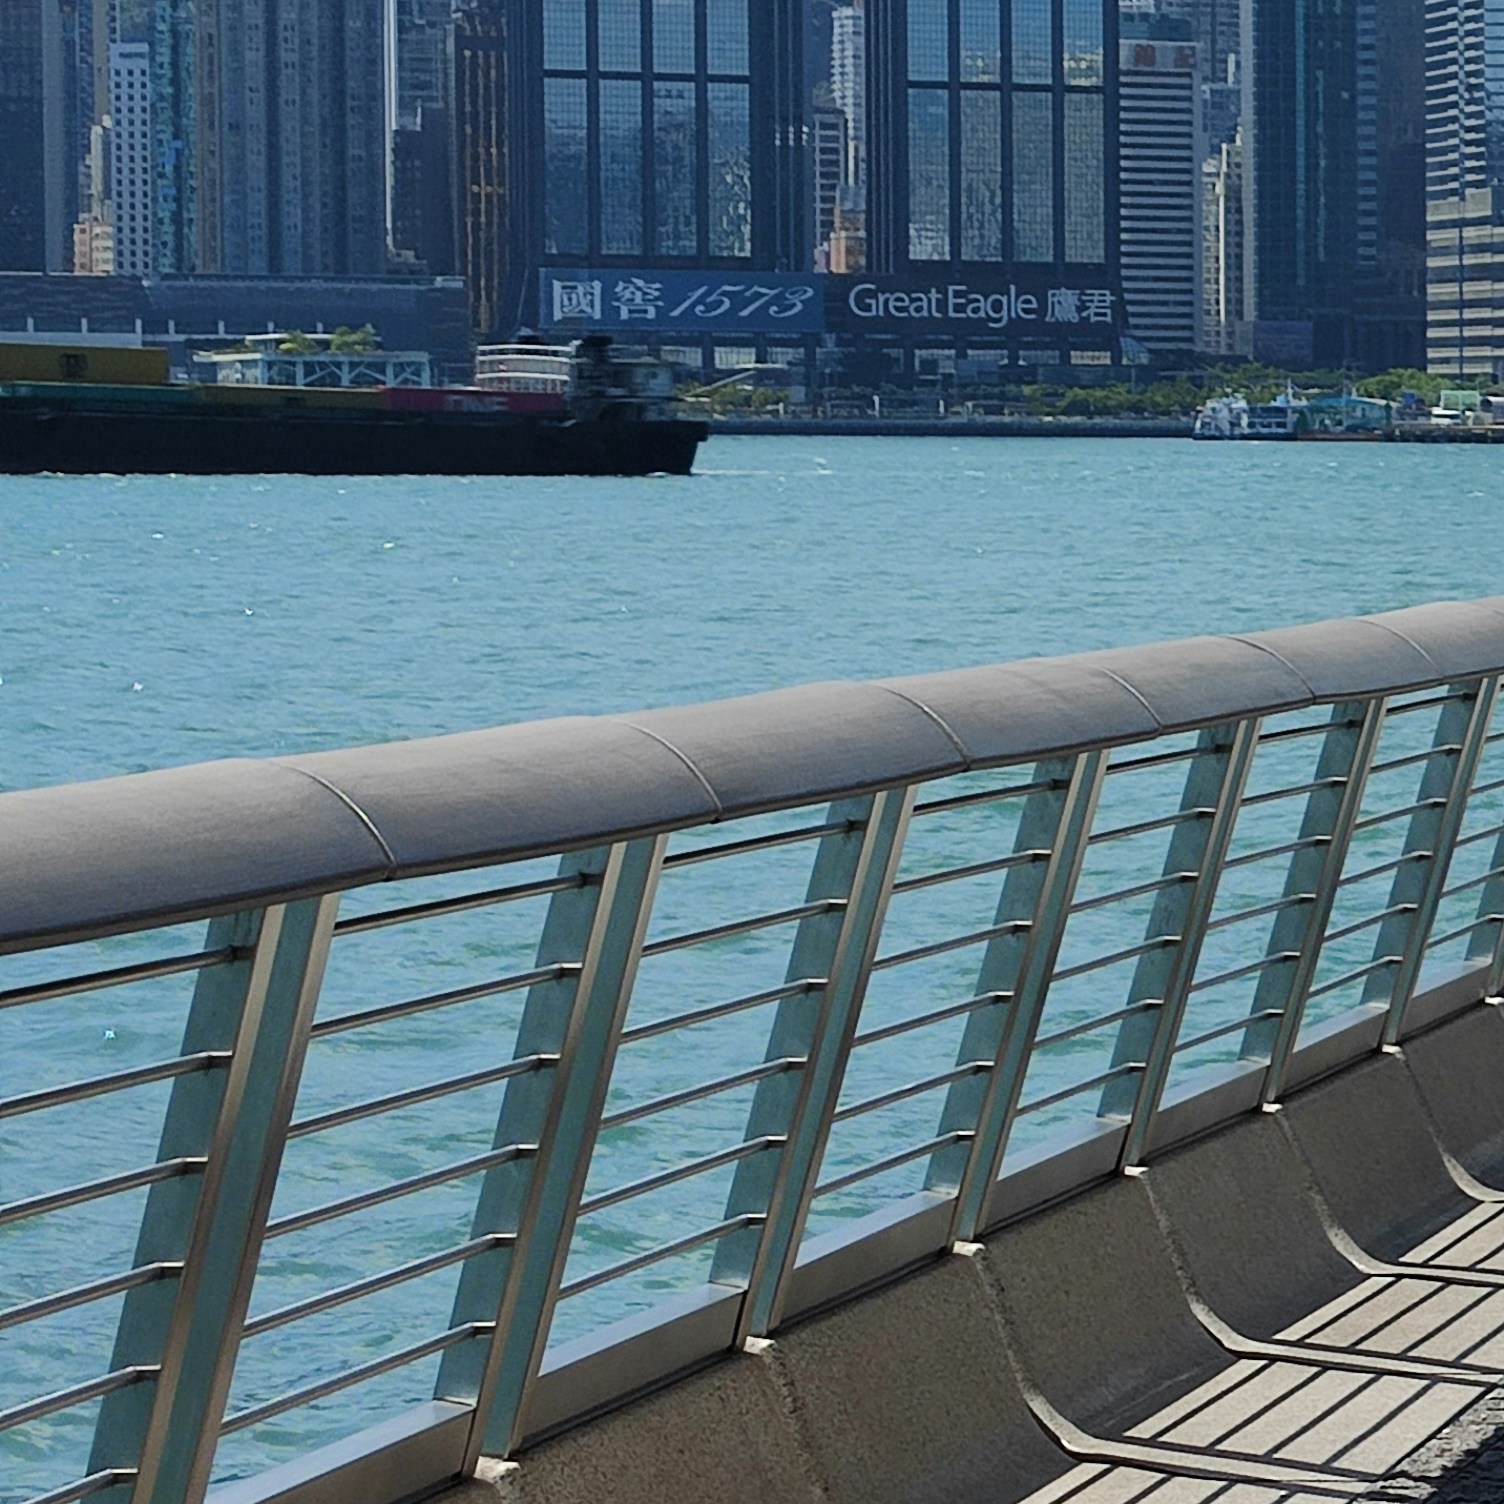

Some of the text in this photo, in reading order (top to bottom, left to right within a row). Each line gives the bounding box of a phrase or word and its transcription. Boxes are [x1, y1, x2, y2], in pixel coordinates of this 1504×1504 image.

[849, 283, 1115, 328] Great Eagle 鷹君
